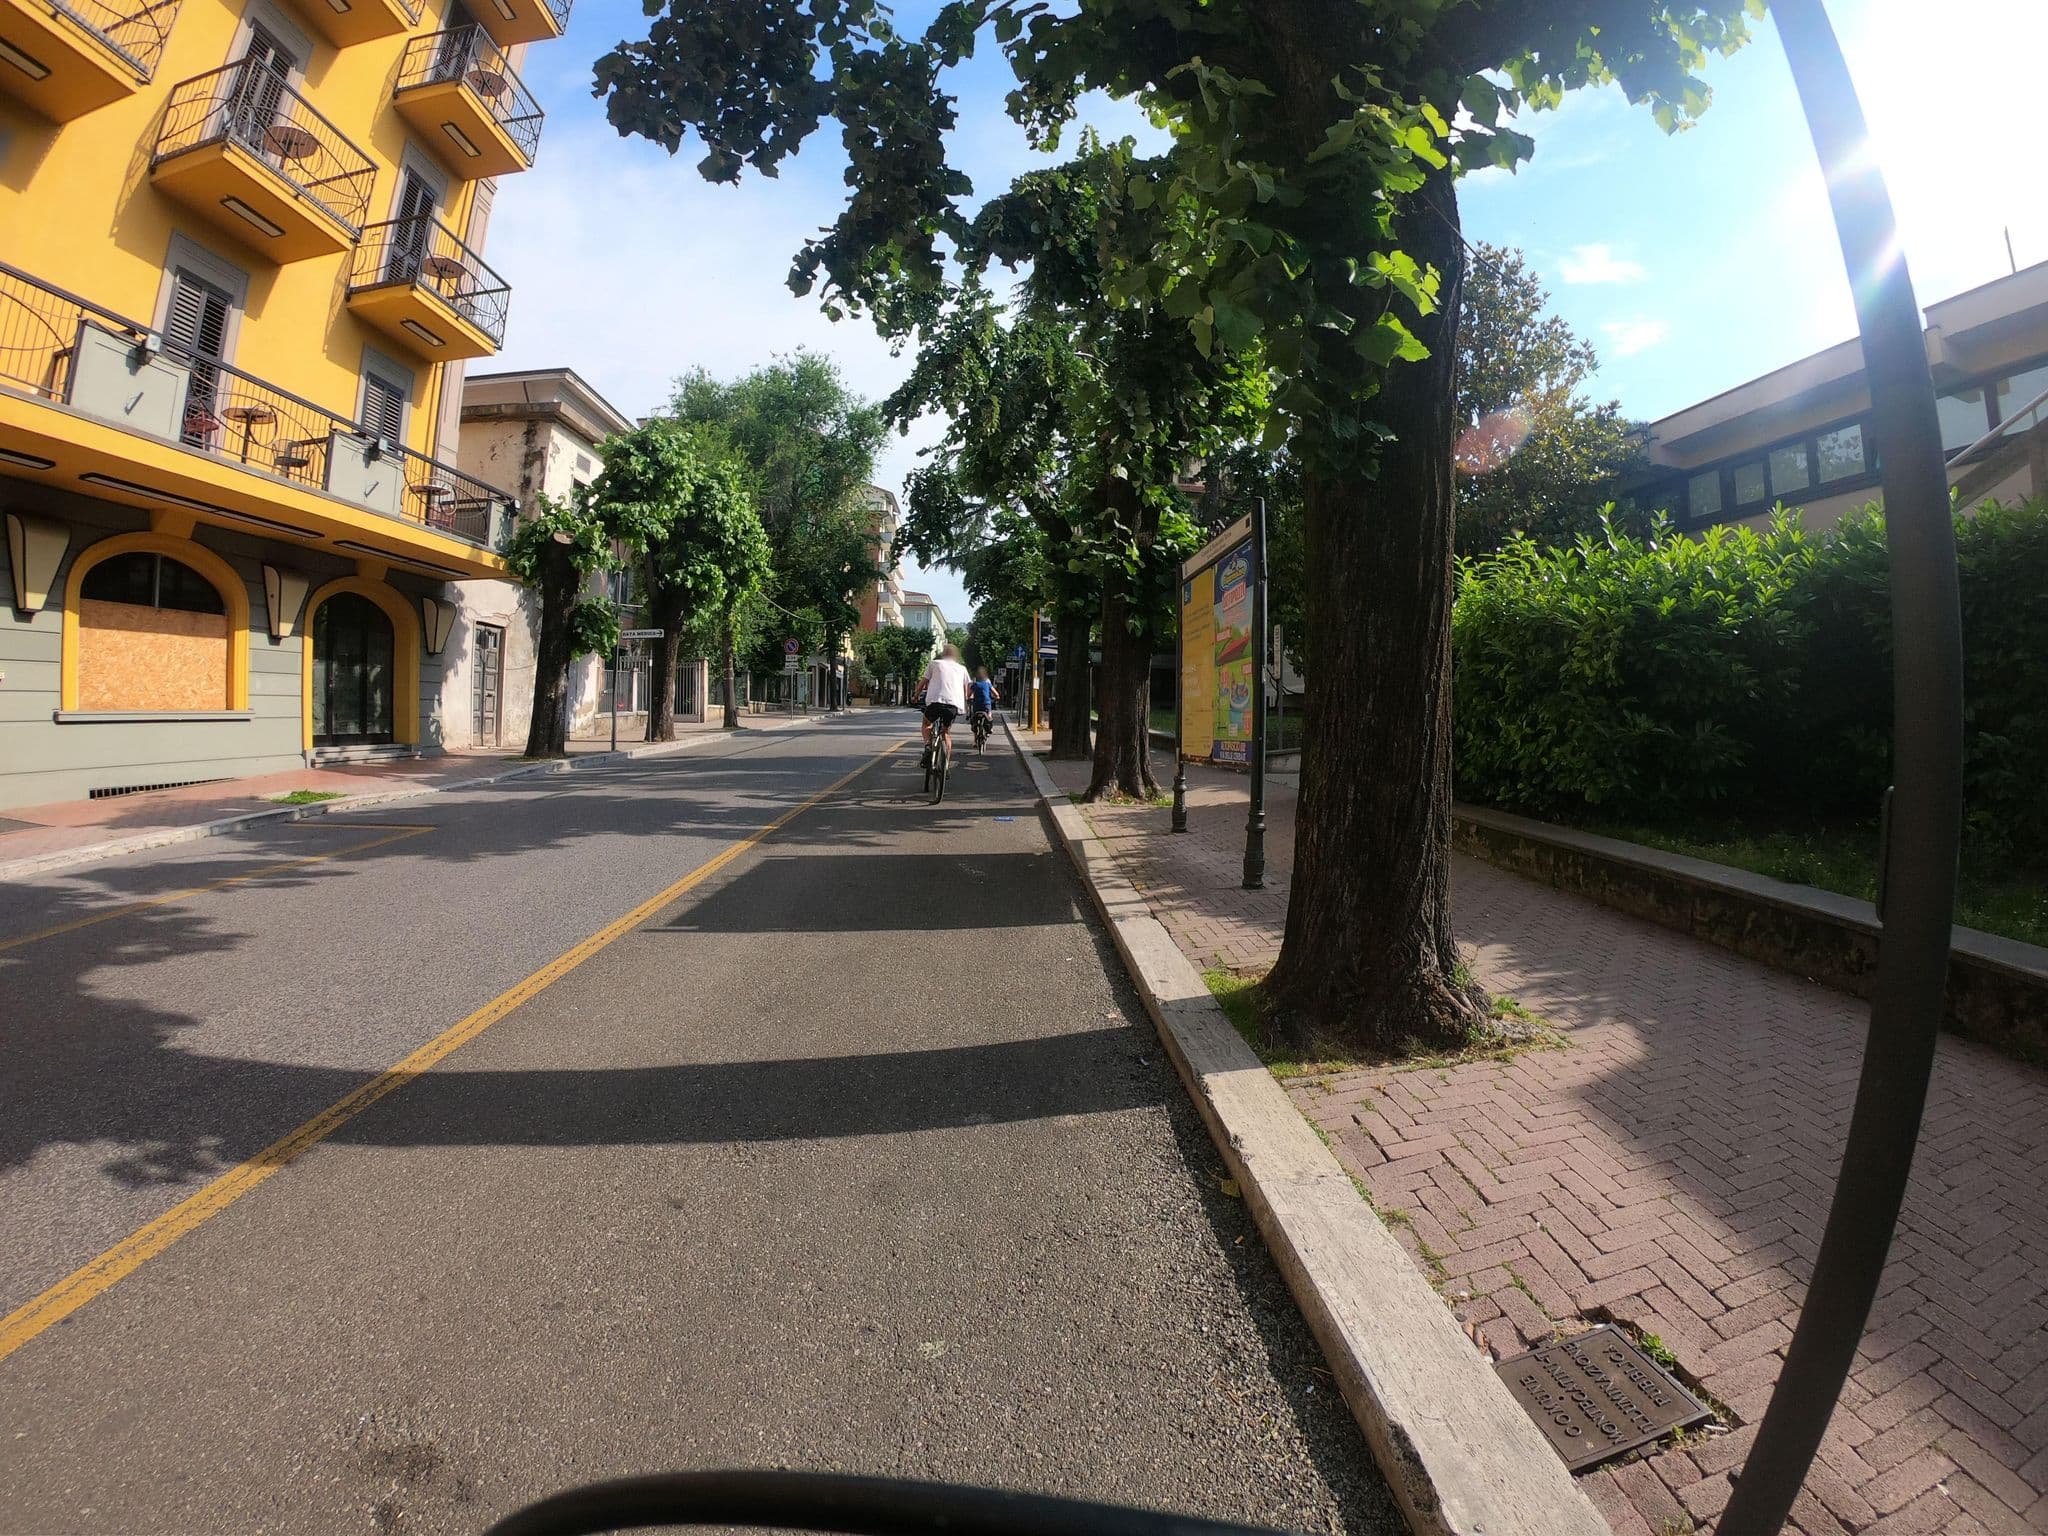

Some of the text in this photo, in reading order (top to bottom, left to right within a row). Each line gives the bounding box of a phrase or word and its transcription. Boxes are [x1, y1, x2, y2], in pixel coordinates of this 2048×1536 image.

[1520, 1375, 1582, 1437] COMUNE
[1562, 1342, 1657, 1434] ILLUMINAZIONE
[1602, 1343, 1671, 1407] PUBBLICA
